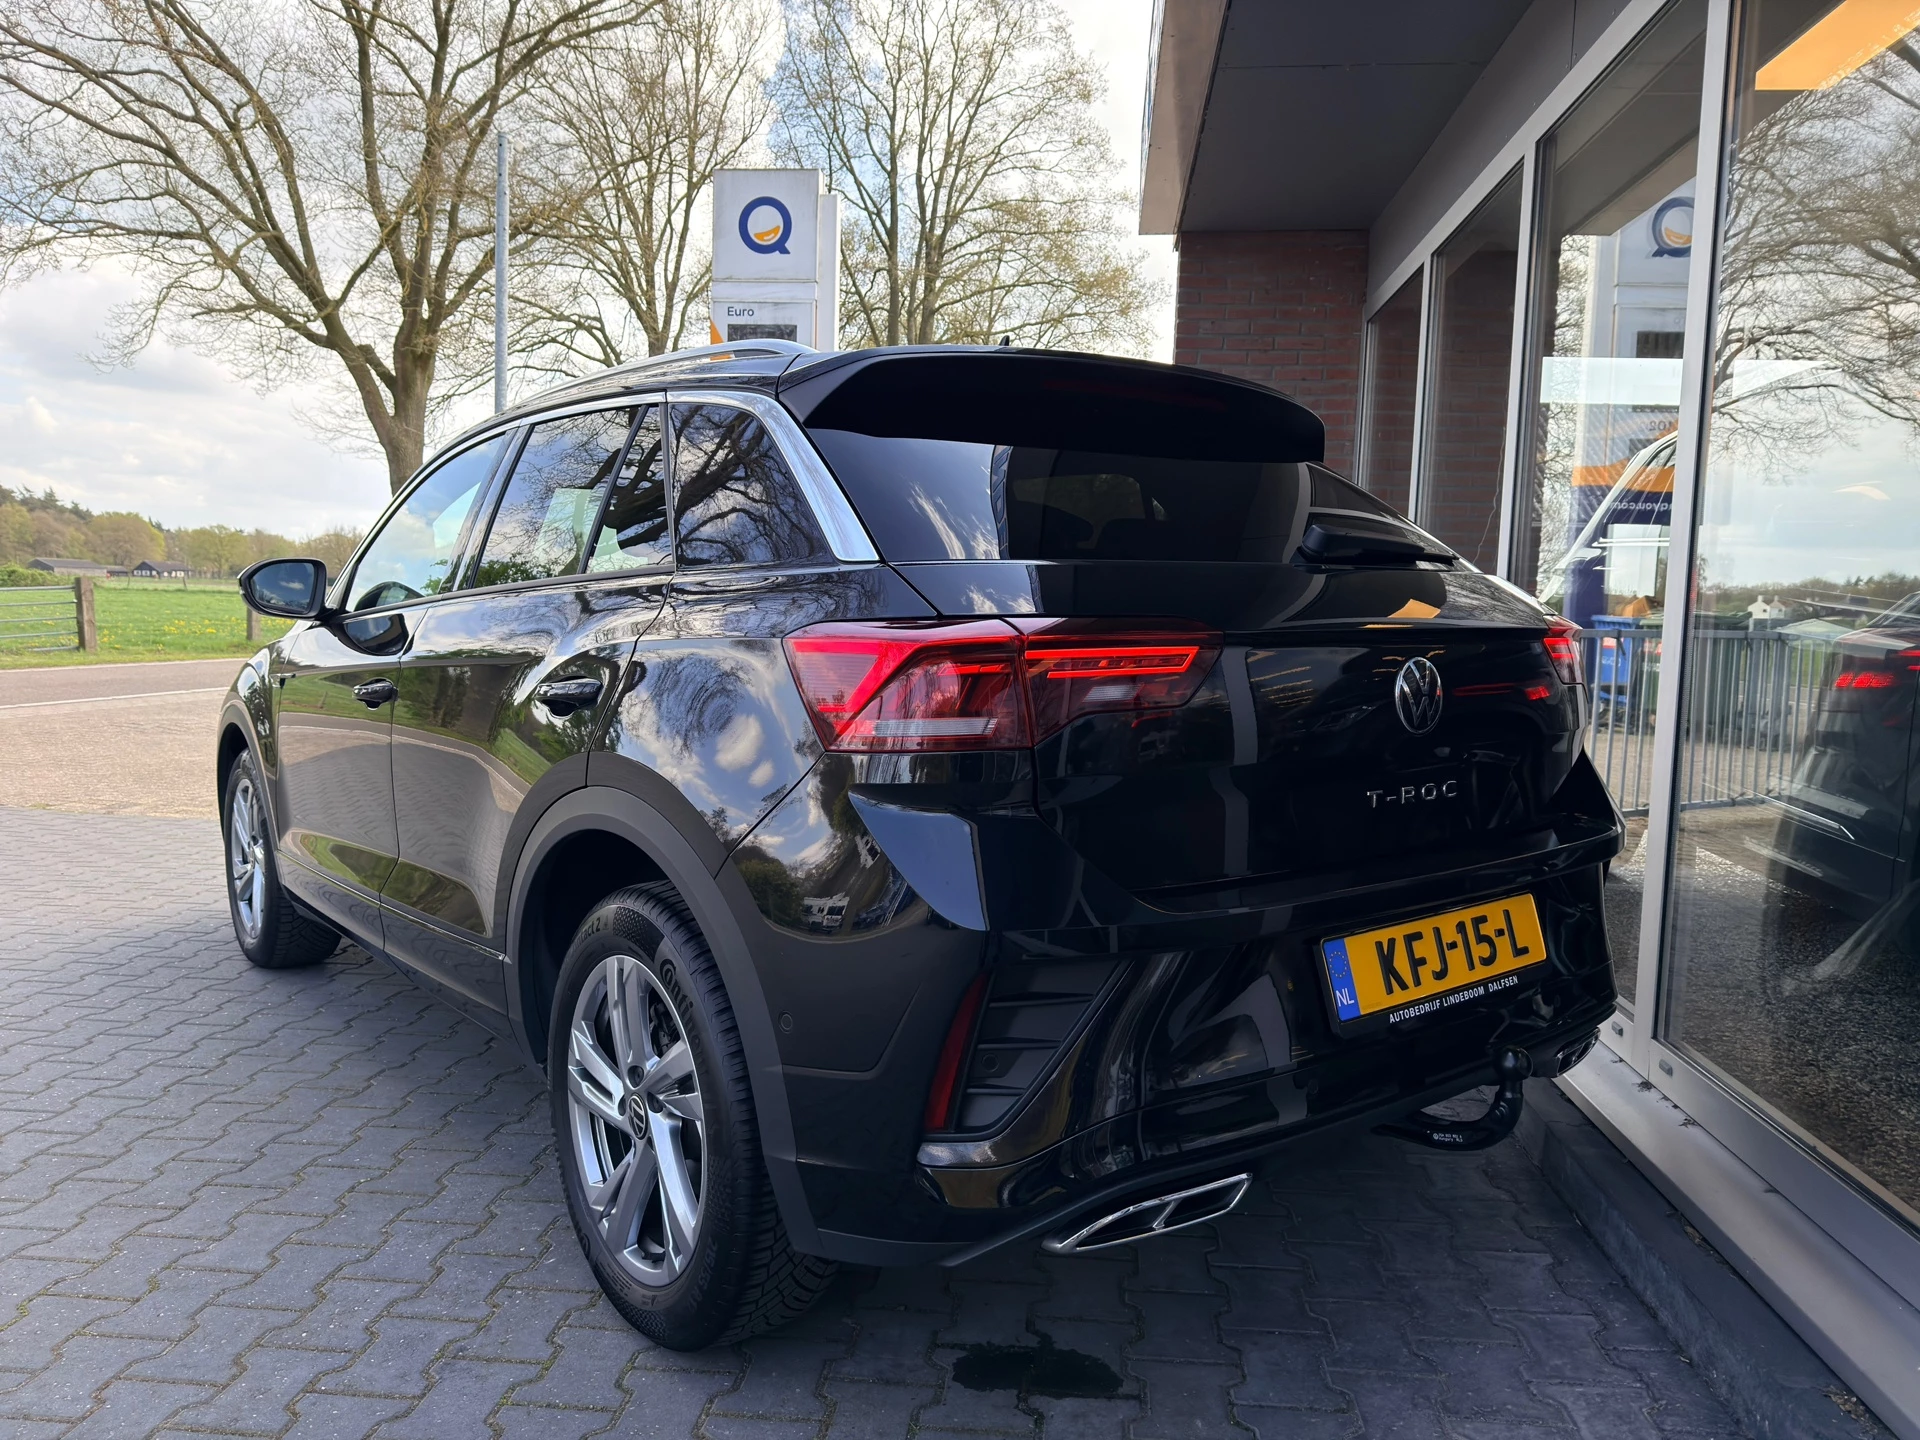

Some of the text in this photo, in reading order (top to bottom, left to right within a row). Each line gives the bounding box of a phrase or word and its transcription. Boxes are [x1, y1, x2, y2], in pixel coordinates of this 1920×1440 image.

[727, 306, 755, 317] Euro
[1366, 780, 1458, 808] T-ROC
[1374, 908, 1530, 996] KFJ-15-L
[1335, 987, 1354, 1007] NL
[1389, 999, 1441, 1023] AUTOBEDRIJF
[1443, 985, 1485, 1007] LINDEBOOM
[1488, 975, 1518, 992] DALFSEN
